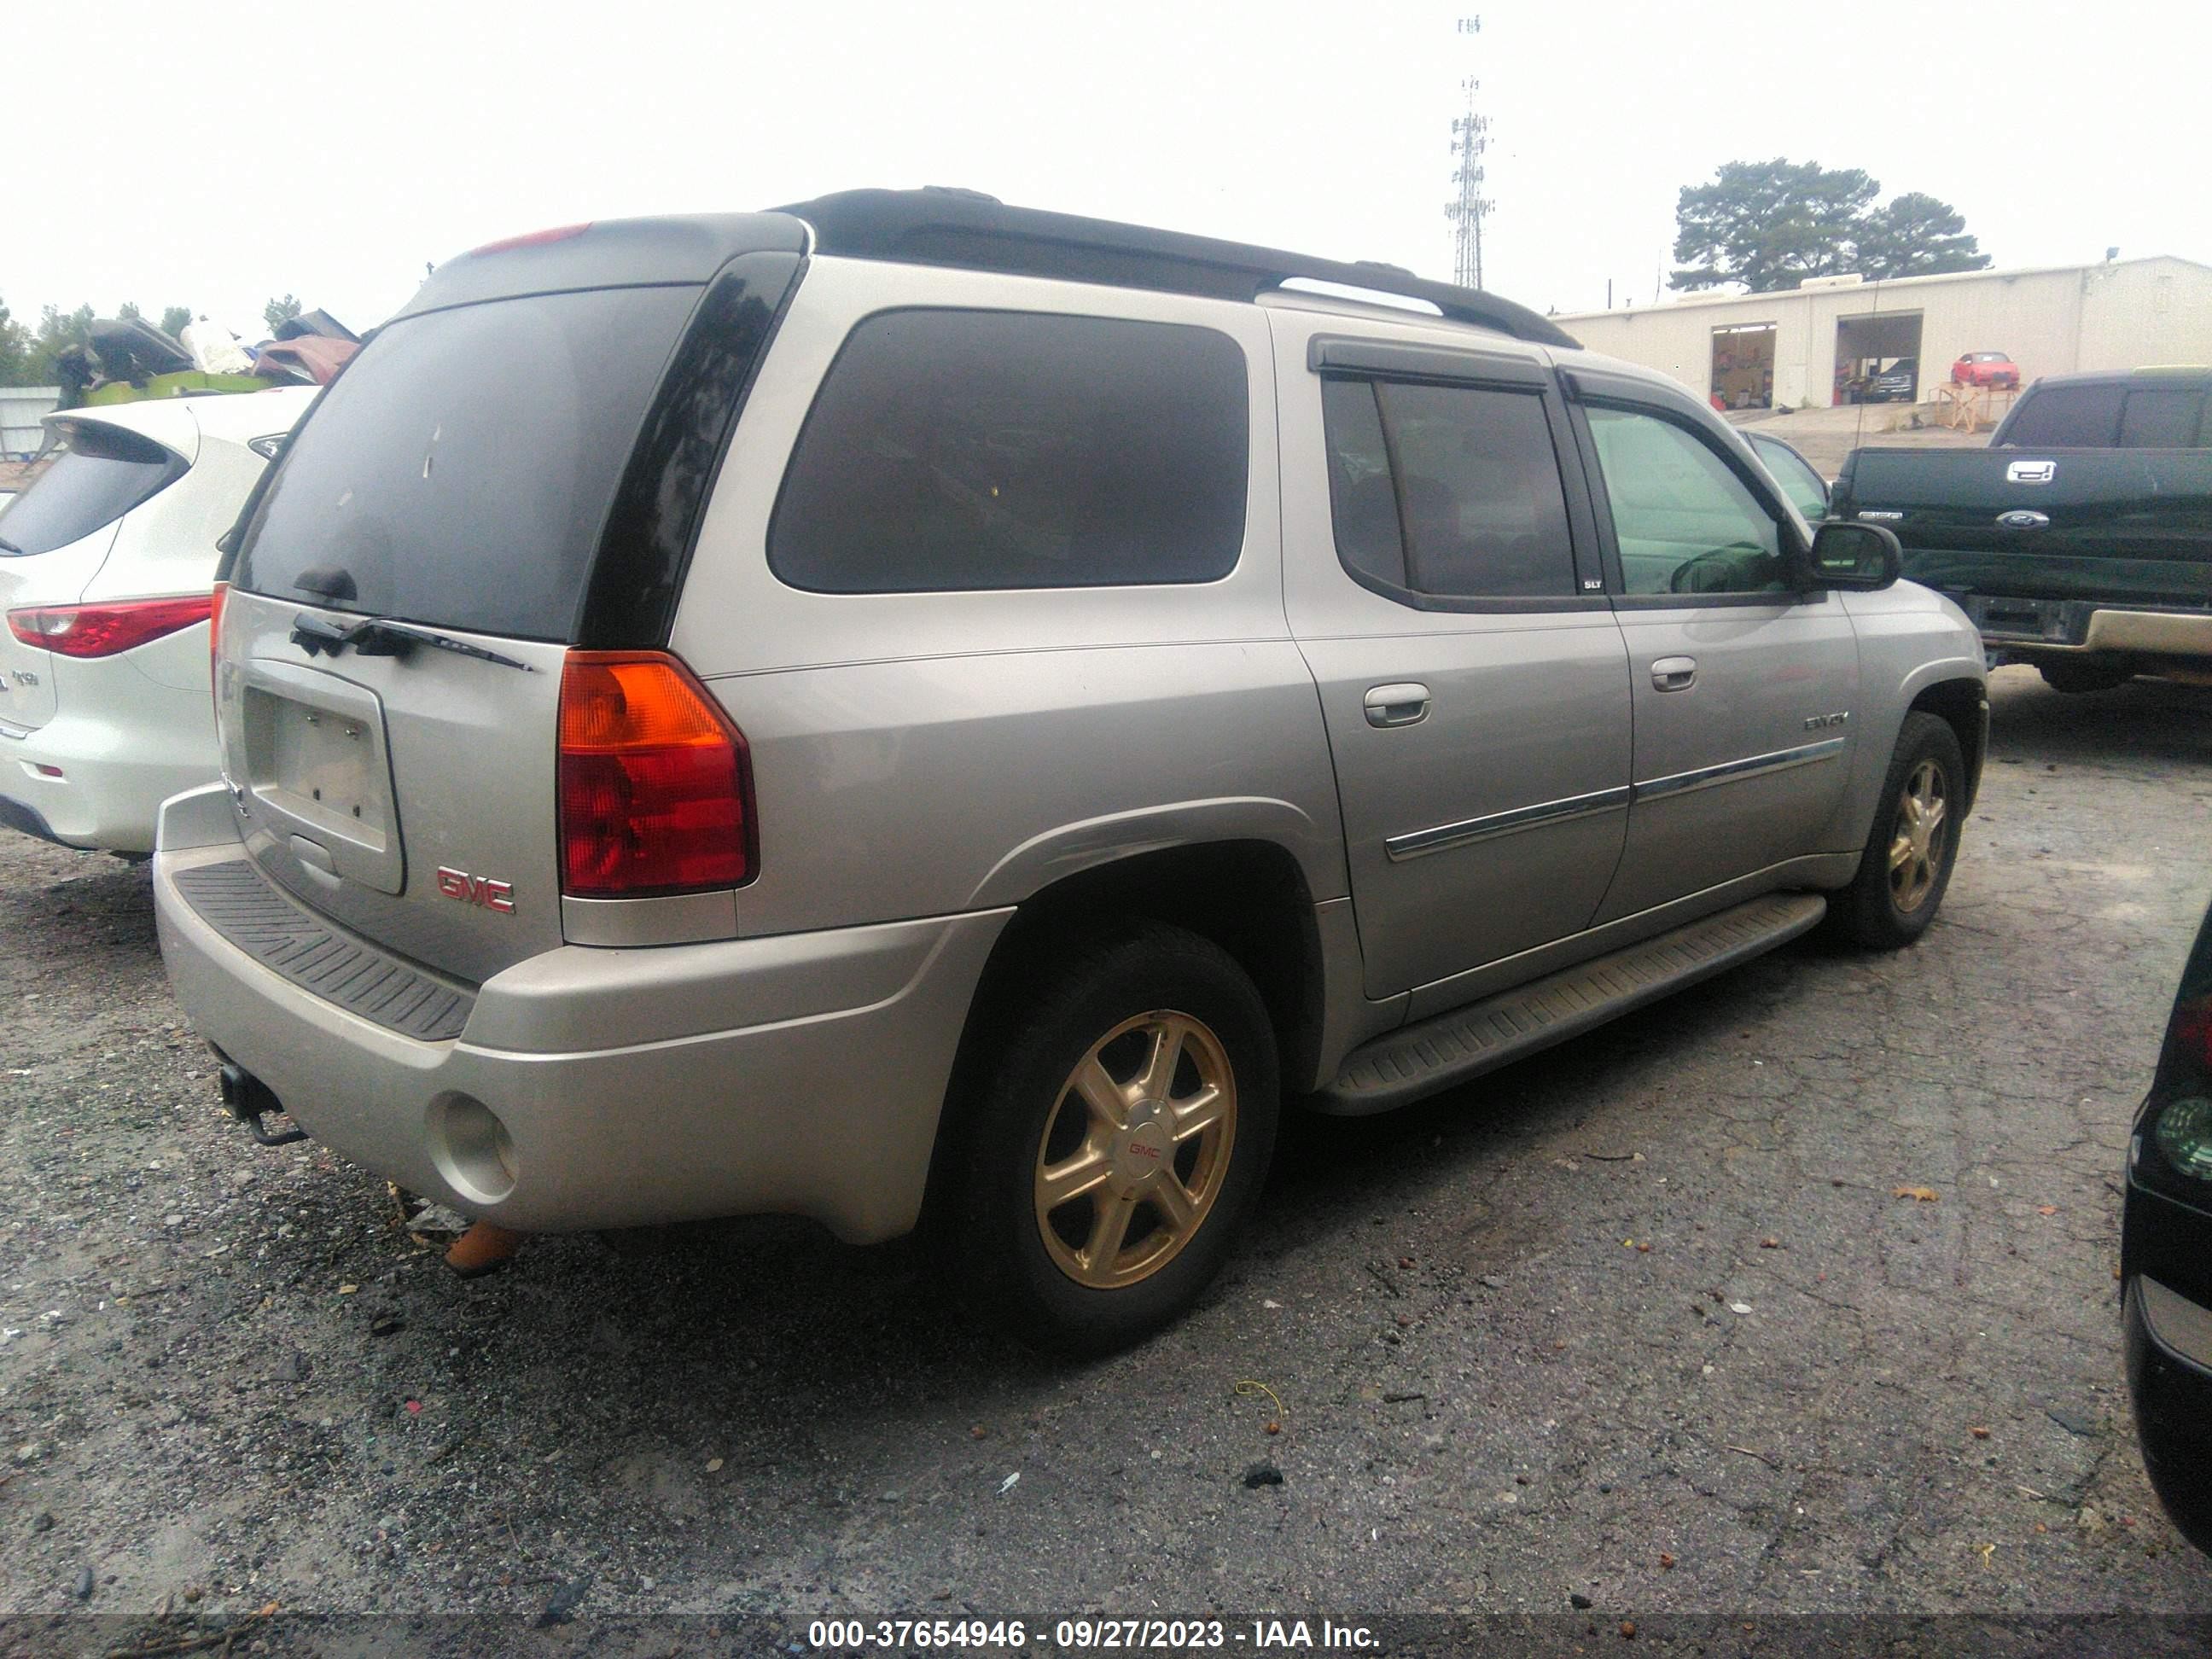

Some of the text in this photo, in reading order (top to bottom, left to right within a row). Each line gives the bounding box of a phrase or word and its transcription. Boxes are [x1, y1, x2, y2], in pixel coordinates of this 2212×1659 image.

[1584, 580, 1602, 589] SLT
[437, 865, 516, 915] GMC
[1129, 1143, 1161, 1159] GMC
